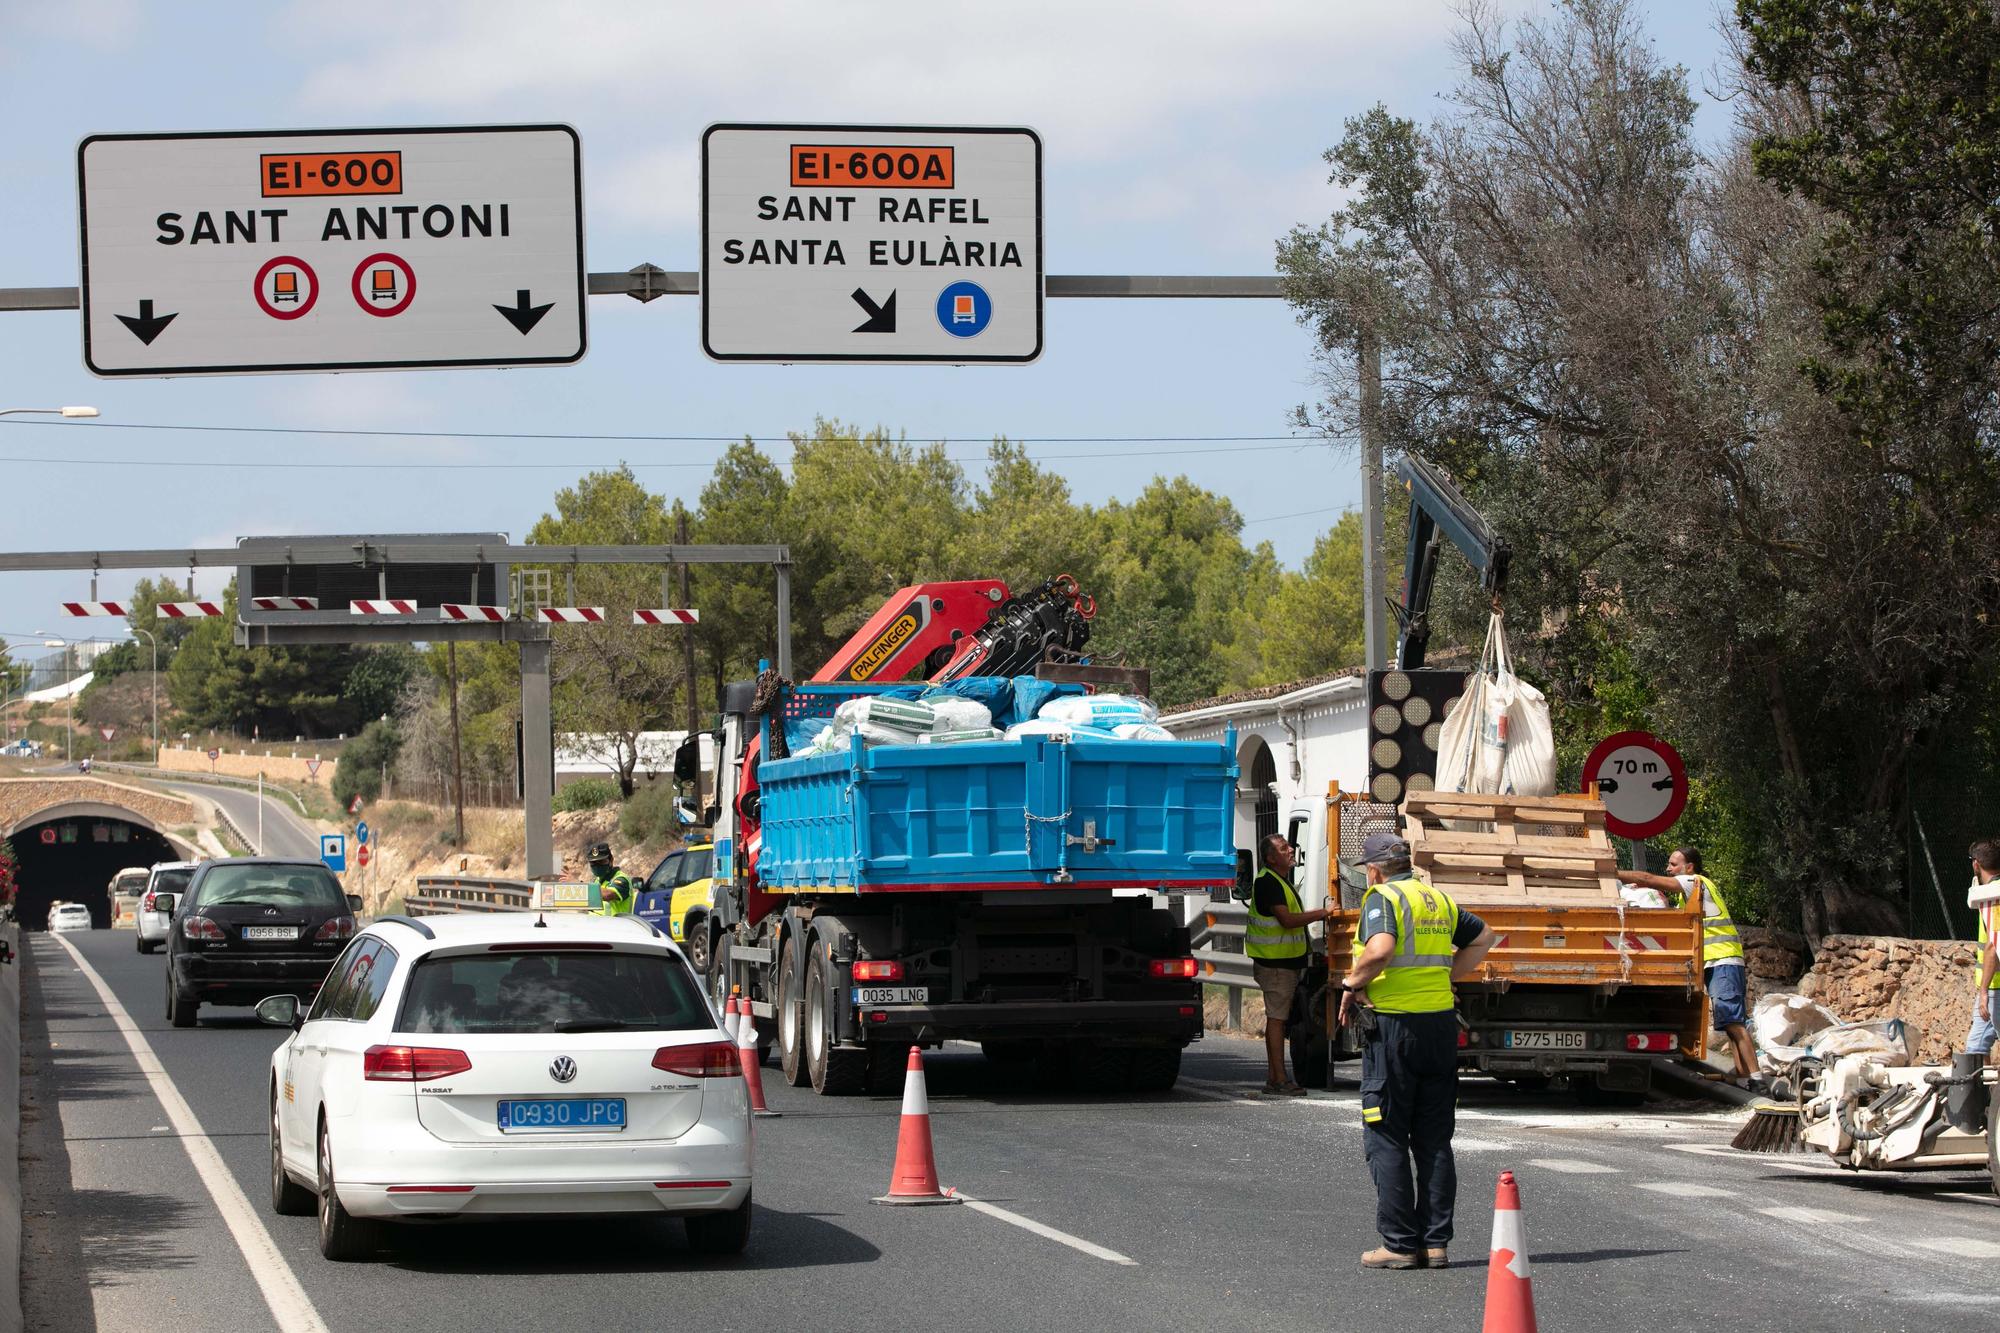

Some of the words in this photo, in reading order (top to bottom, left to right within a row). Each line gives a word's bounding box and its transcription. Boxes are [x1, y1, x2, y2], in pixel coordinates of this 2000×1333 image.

[268, 159, 395, 189] EI-600
[798, 152, 946, 181] EI-600A
[757, 196, 856, 222] SANT
[879, 197, 989, 224] RAFEL
[156, 209, 288, 245] SANT
[321, 204, 509, 241] ANTONI
[723, 239, 846, 265] SANTA
[870, 235, 1022, 267] EULÀRIA
[854, 619, 913, 677] PALFINGER
[1614, 760, 1638, 774] 70
[1642, 762, 1657, 773] m
[557, 885, 586, 898] TAXI
[250, 928, 271, 938] 0956
[277, 927, 294, 937] BSL
[862, 989, 894, 1002] 0035
[900, 989, 924, 1002] LNG
[1514, 1032, 1550, 1046] 5775
[1555, 1033, 1582, 1047] HDG
[514, 1103, 570, 1124] 0930
[578, 1102, 620, 1122] JPG
